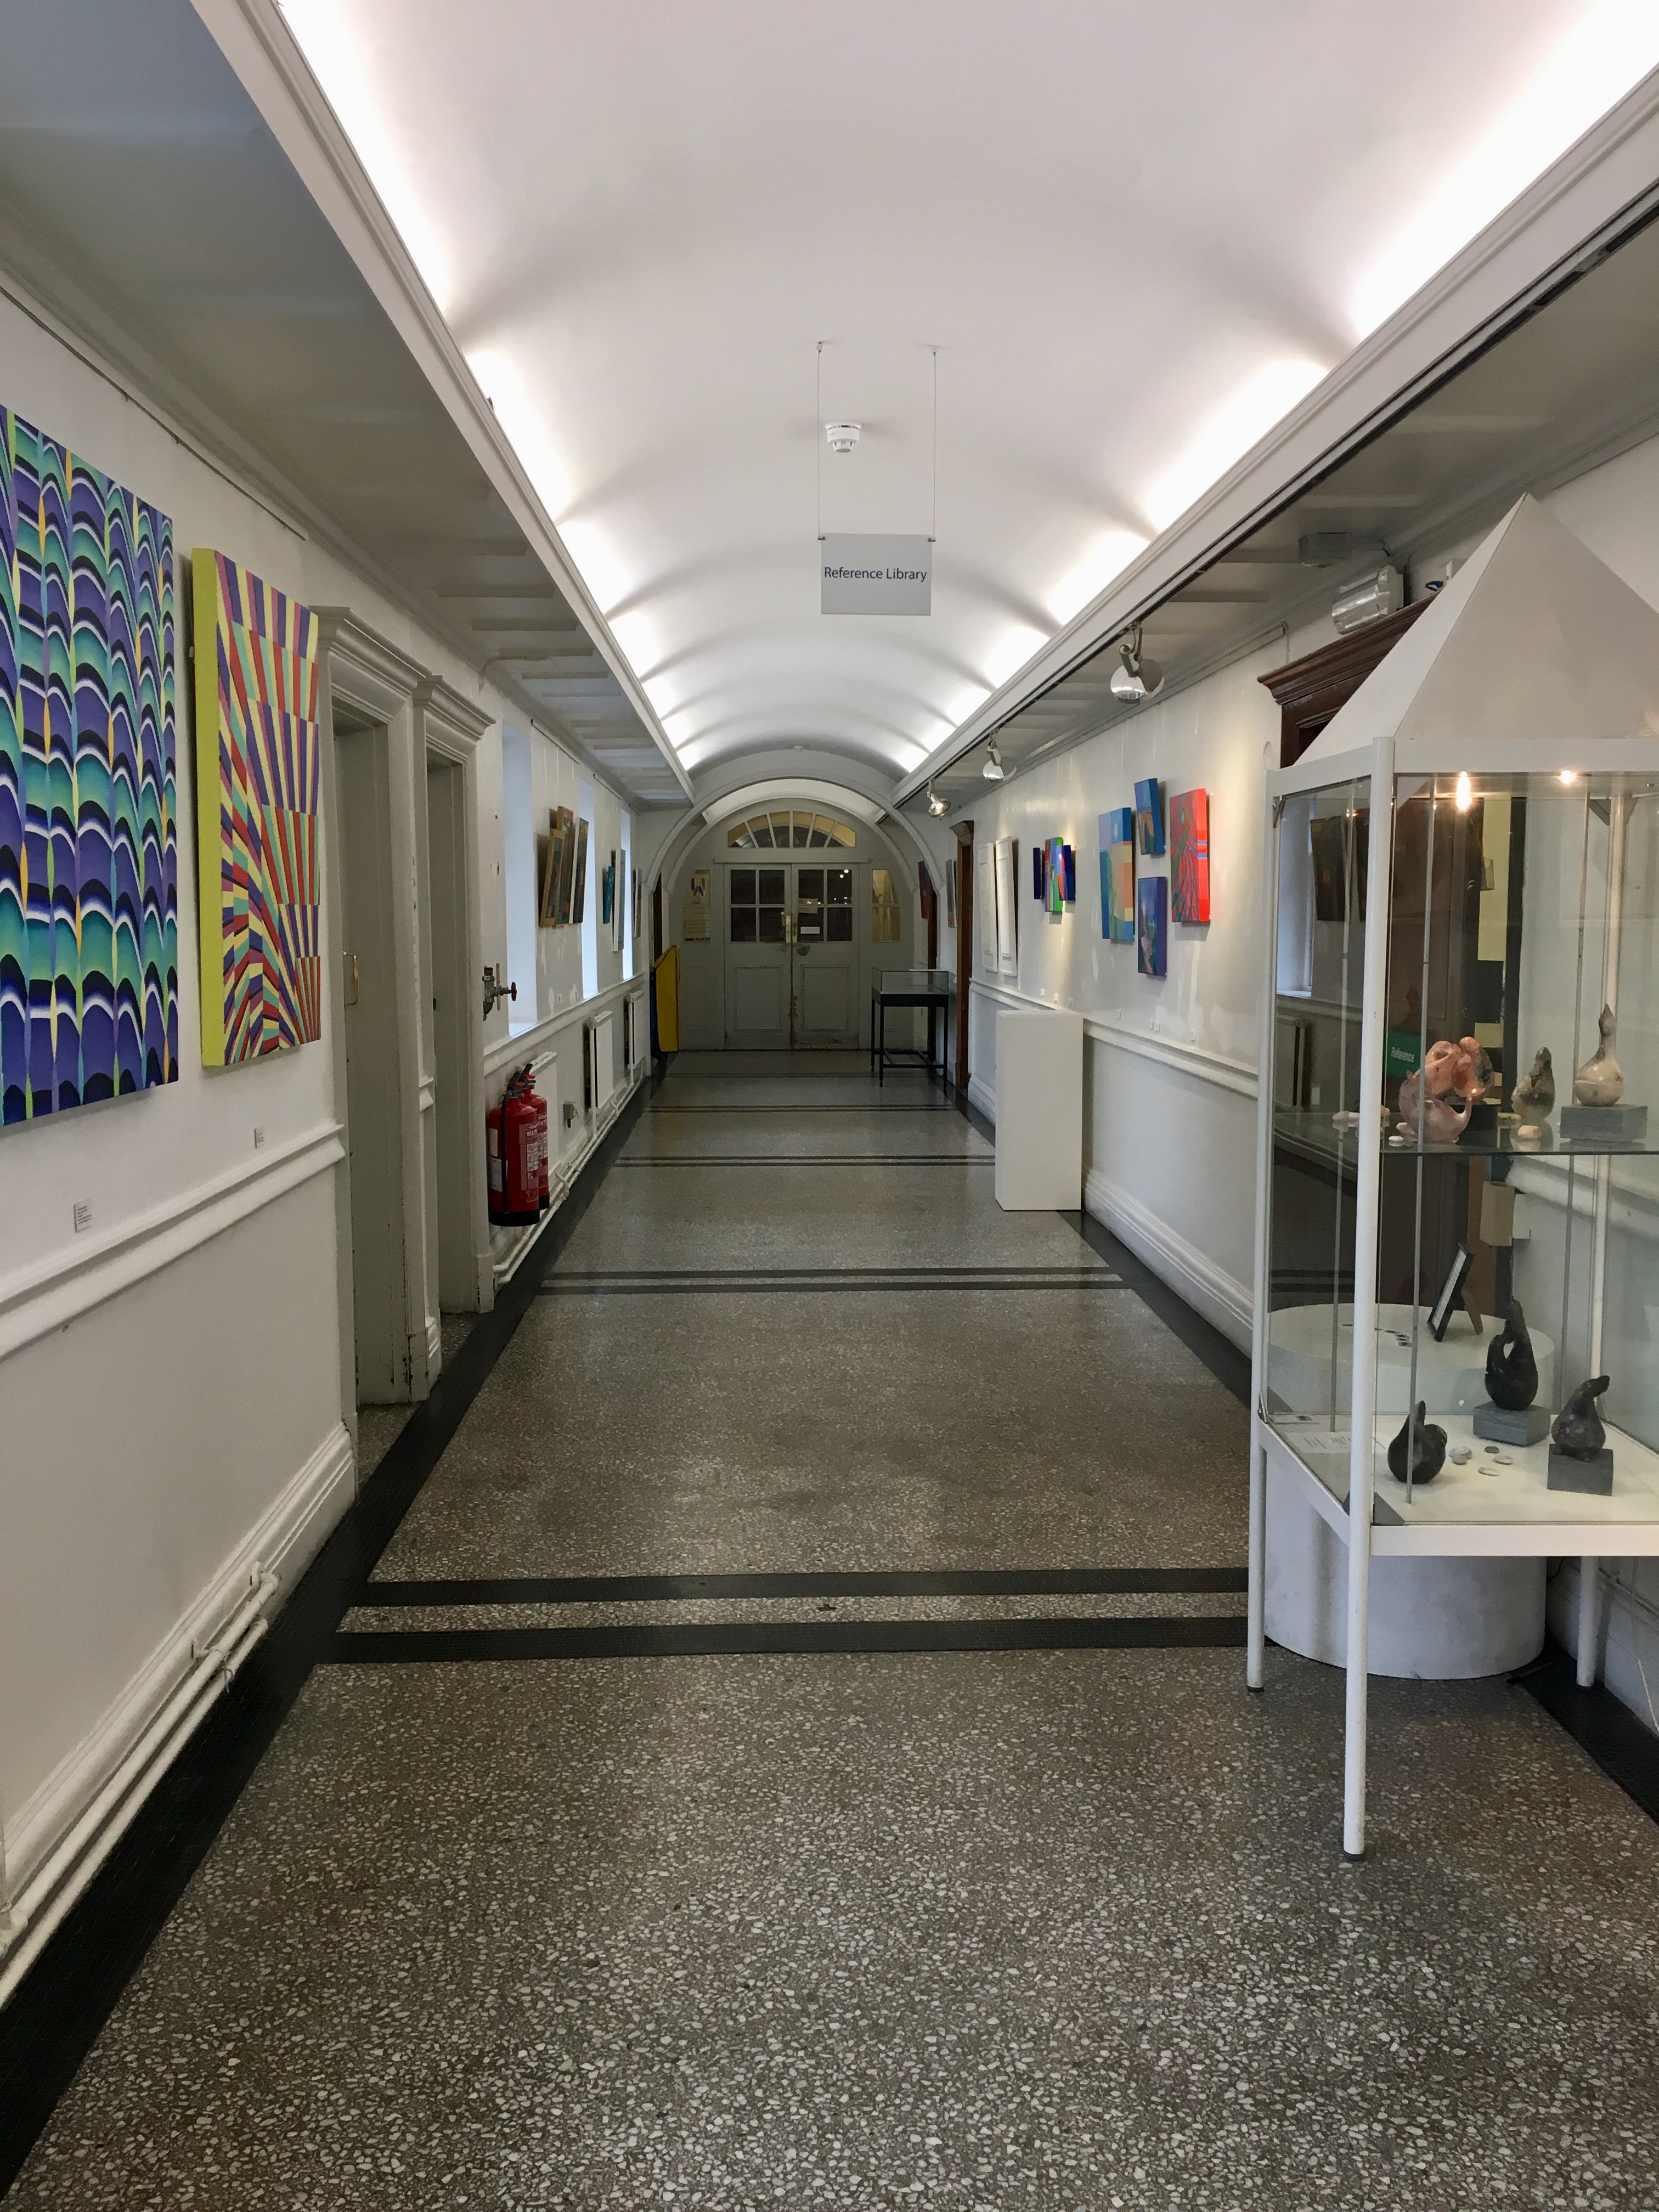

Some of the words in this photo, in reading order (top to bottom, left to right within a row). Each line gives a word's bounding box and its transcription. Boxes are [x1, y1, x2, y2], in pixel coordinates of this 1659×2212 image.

[824, 566, 883, 579] Reference
[886, 568, 927, 583] Library
[1391, 1046, 1415, 1063] Reference
